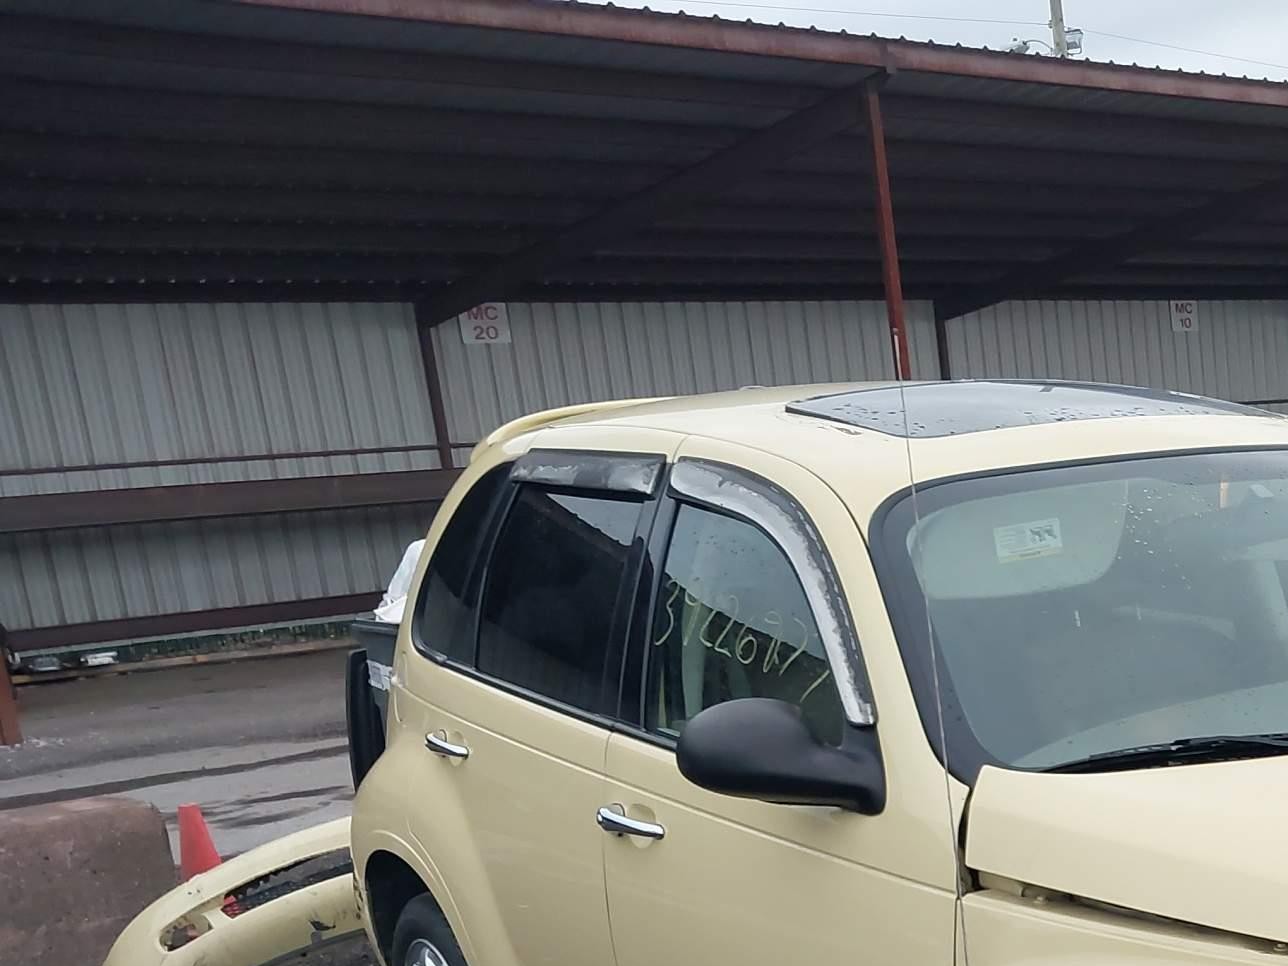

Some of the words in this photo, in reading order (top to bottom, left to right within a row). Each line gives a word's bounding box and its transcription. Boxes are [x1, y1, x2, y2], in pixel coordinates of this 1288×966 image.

[467, 305, 499, 320] MC
[1175, 303, 1193, 314] MC
[1179, 318, 1192, 329] 10
[473, 325, 499, 340] 20
